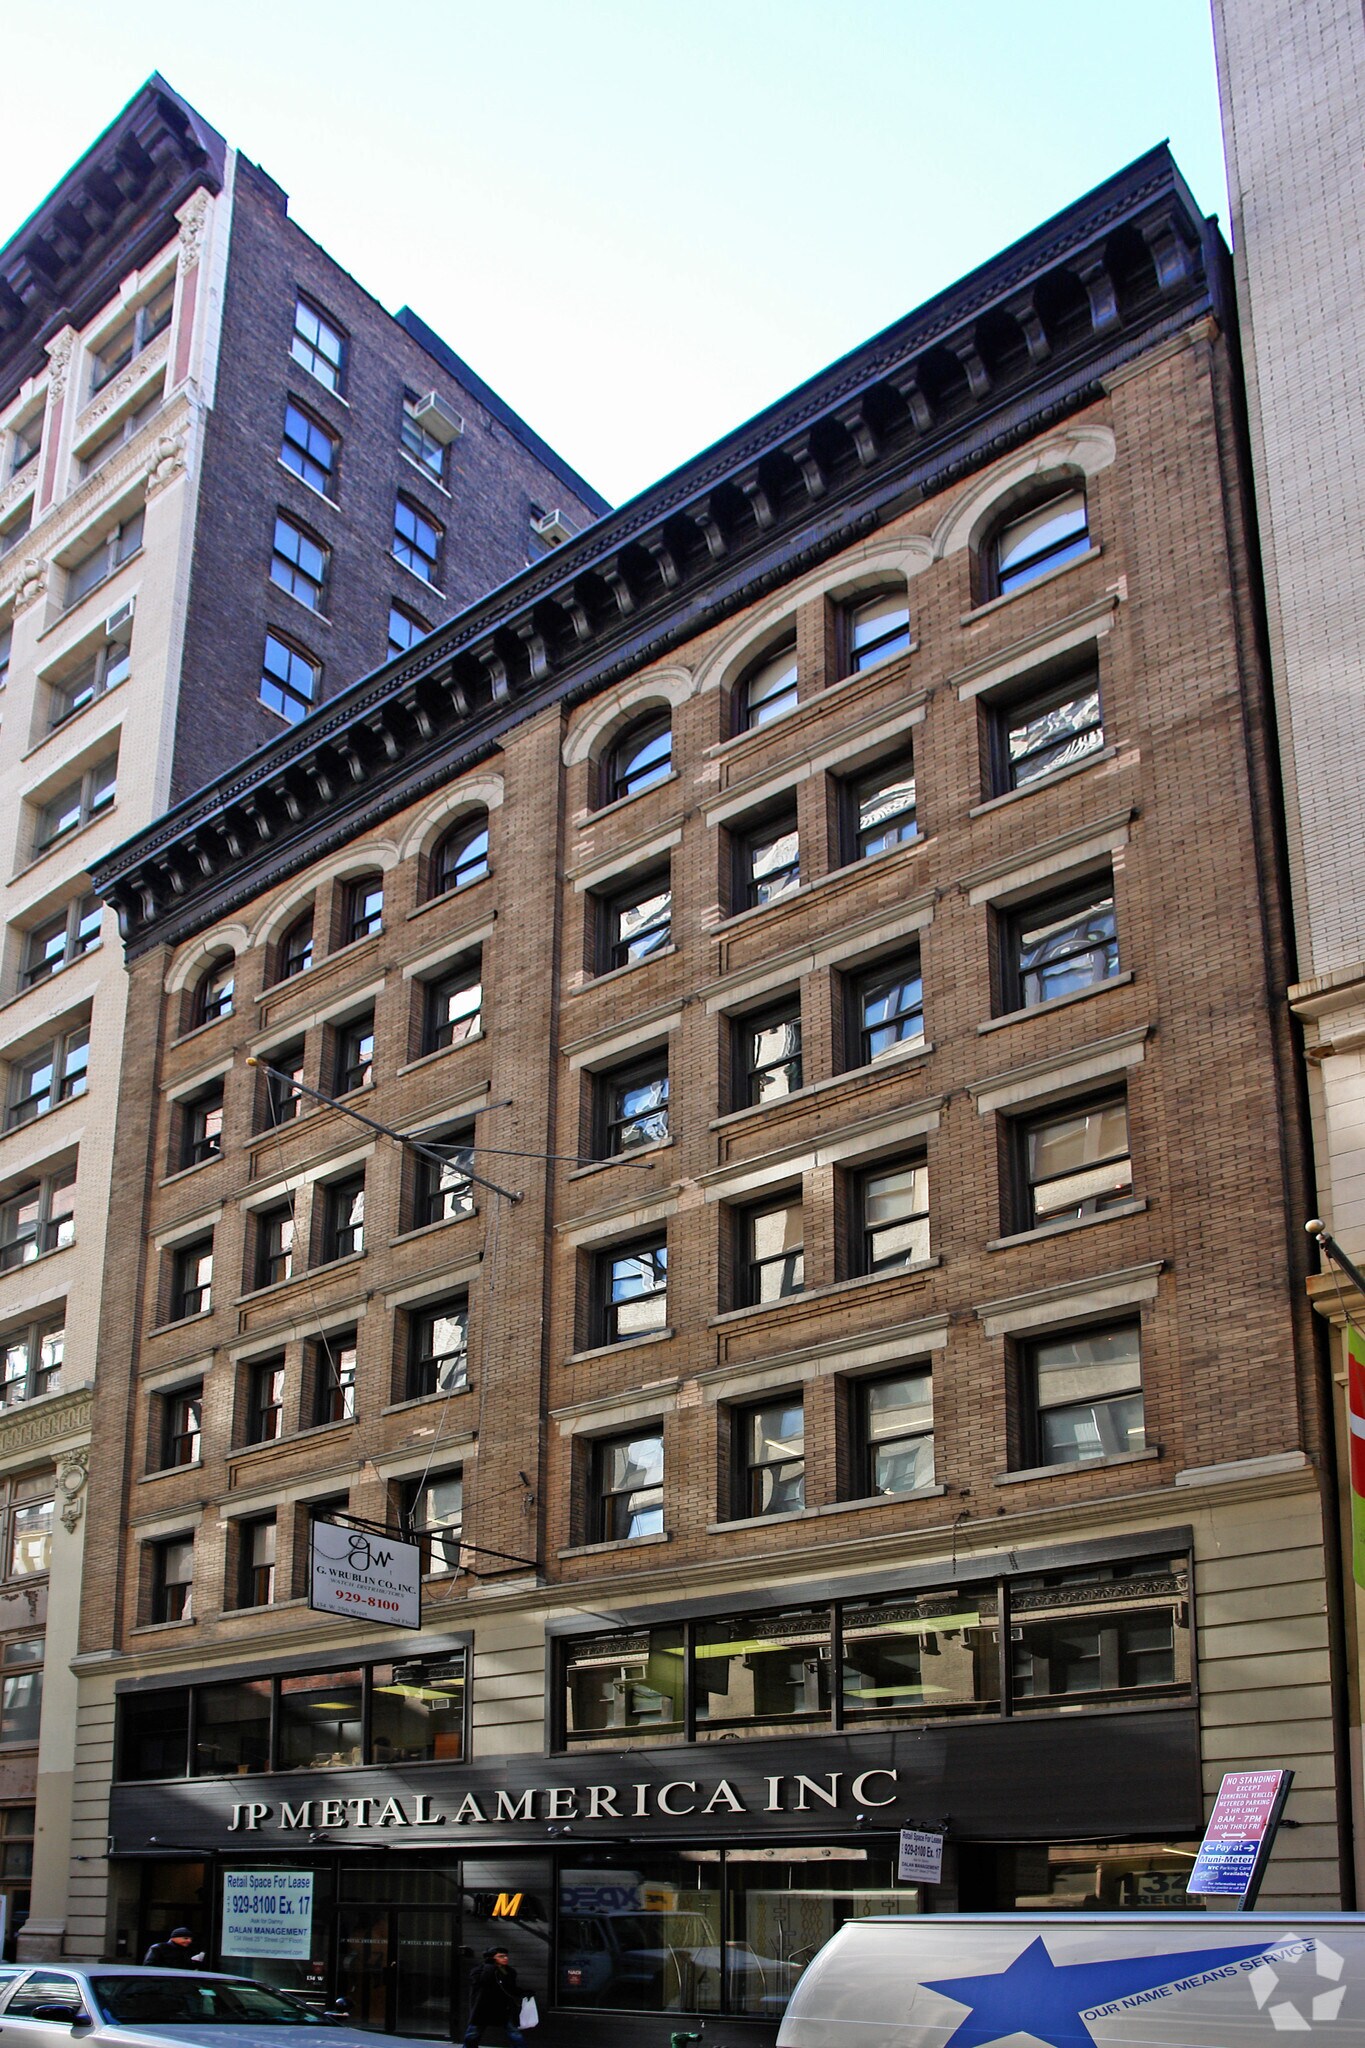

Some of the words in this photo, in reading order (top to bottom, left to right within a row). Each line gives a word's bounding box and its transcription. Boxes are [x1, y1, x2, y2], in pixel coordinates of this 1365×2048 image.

[316, 1566, 326, 1575] G.
[329, 1568, 376, 1585] WRUBLIN
[398, 1584, 416, 1594] INC.
[330, 1578, 354, 1587] WATCH
[356, 1584, 404, 1598] DISTRIBUTORS
[336, 1590, 399, 1612] 929-8100
[351, 1608, 368, 1616] Street
[1239, 1775, 1276, 1784] STANDING
[227, 1802, 268, 1831] JP
[278, 1794, 443, 1829] METAL
[451, 1779, 747, 1823] AMERICA
[763, 1769, 897, 1811] INC
[905, 1844, 926, 1856] 929-8100
[1215, 1844, 1231, 1853] Pay
[227, 1875, 248, 1888] Retail
[249, 1875, 272, 1891] Space
[274, 1875, 286, 1888] For
[288, 1876, 310, 1888] Lease
[232, 1895, 276, 1914] 929-8100
[279, 1896, 294, 1914] Ex.
[299, 1896, 310, 1914] 17
[228, 1926, 252, 1934] DALAN
[254, 1927, 307, 1936] MANAGEMENT
[1084, 2003, 1120, 2021] OUR
[1122, 1986, 1173, 2010] NAME
[1174, 1966, 1238, 1992] MEANS
[1240, 1941, 1317, 1972] SERVICE
